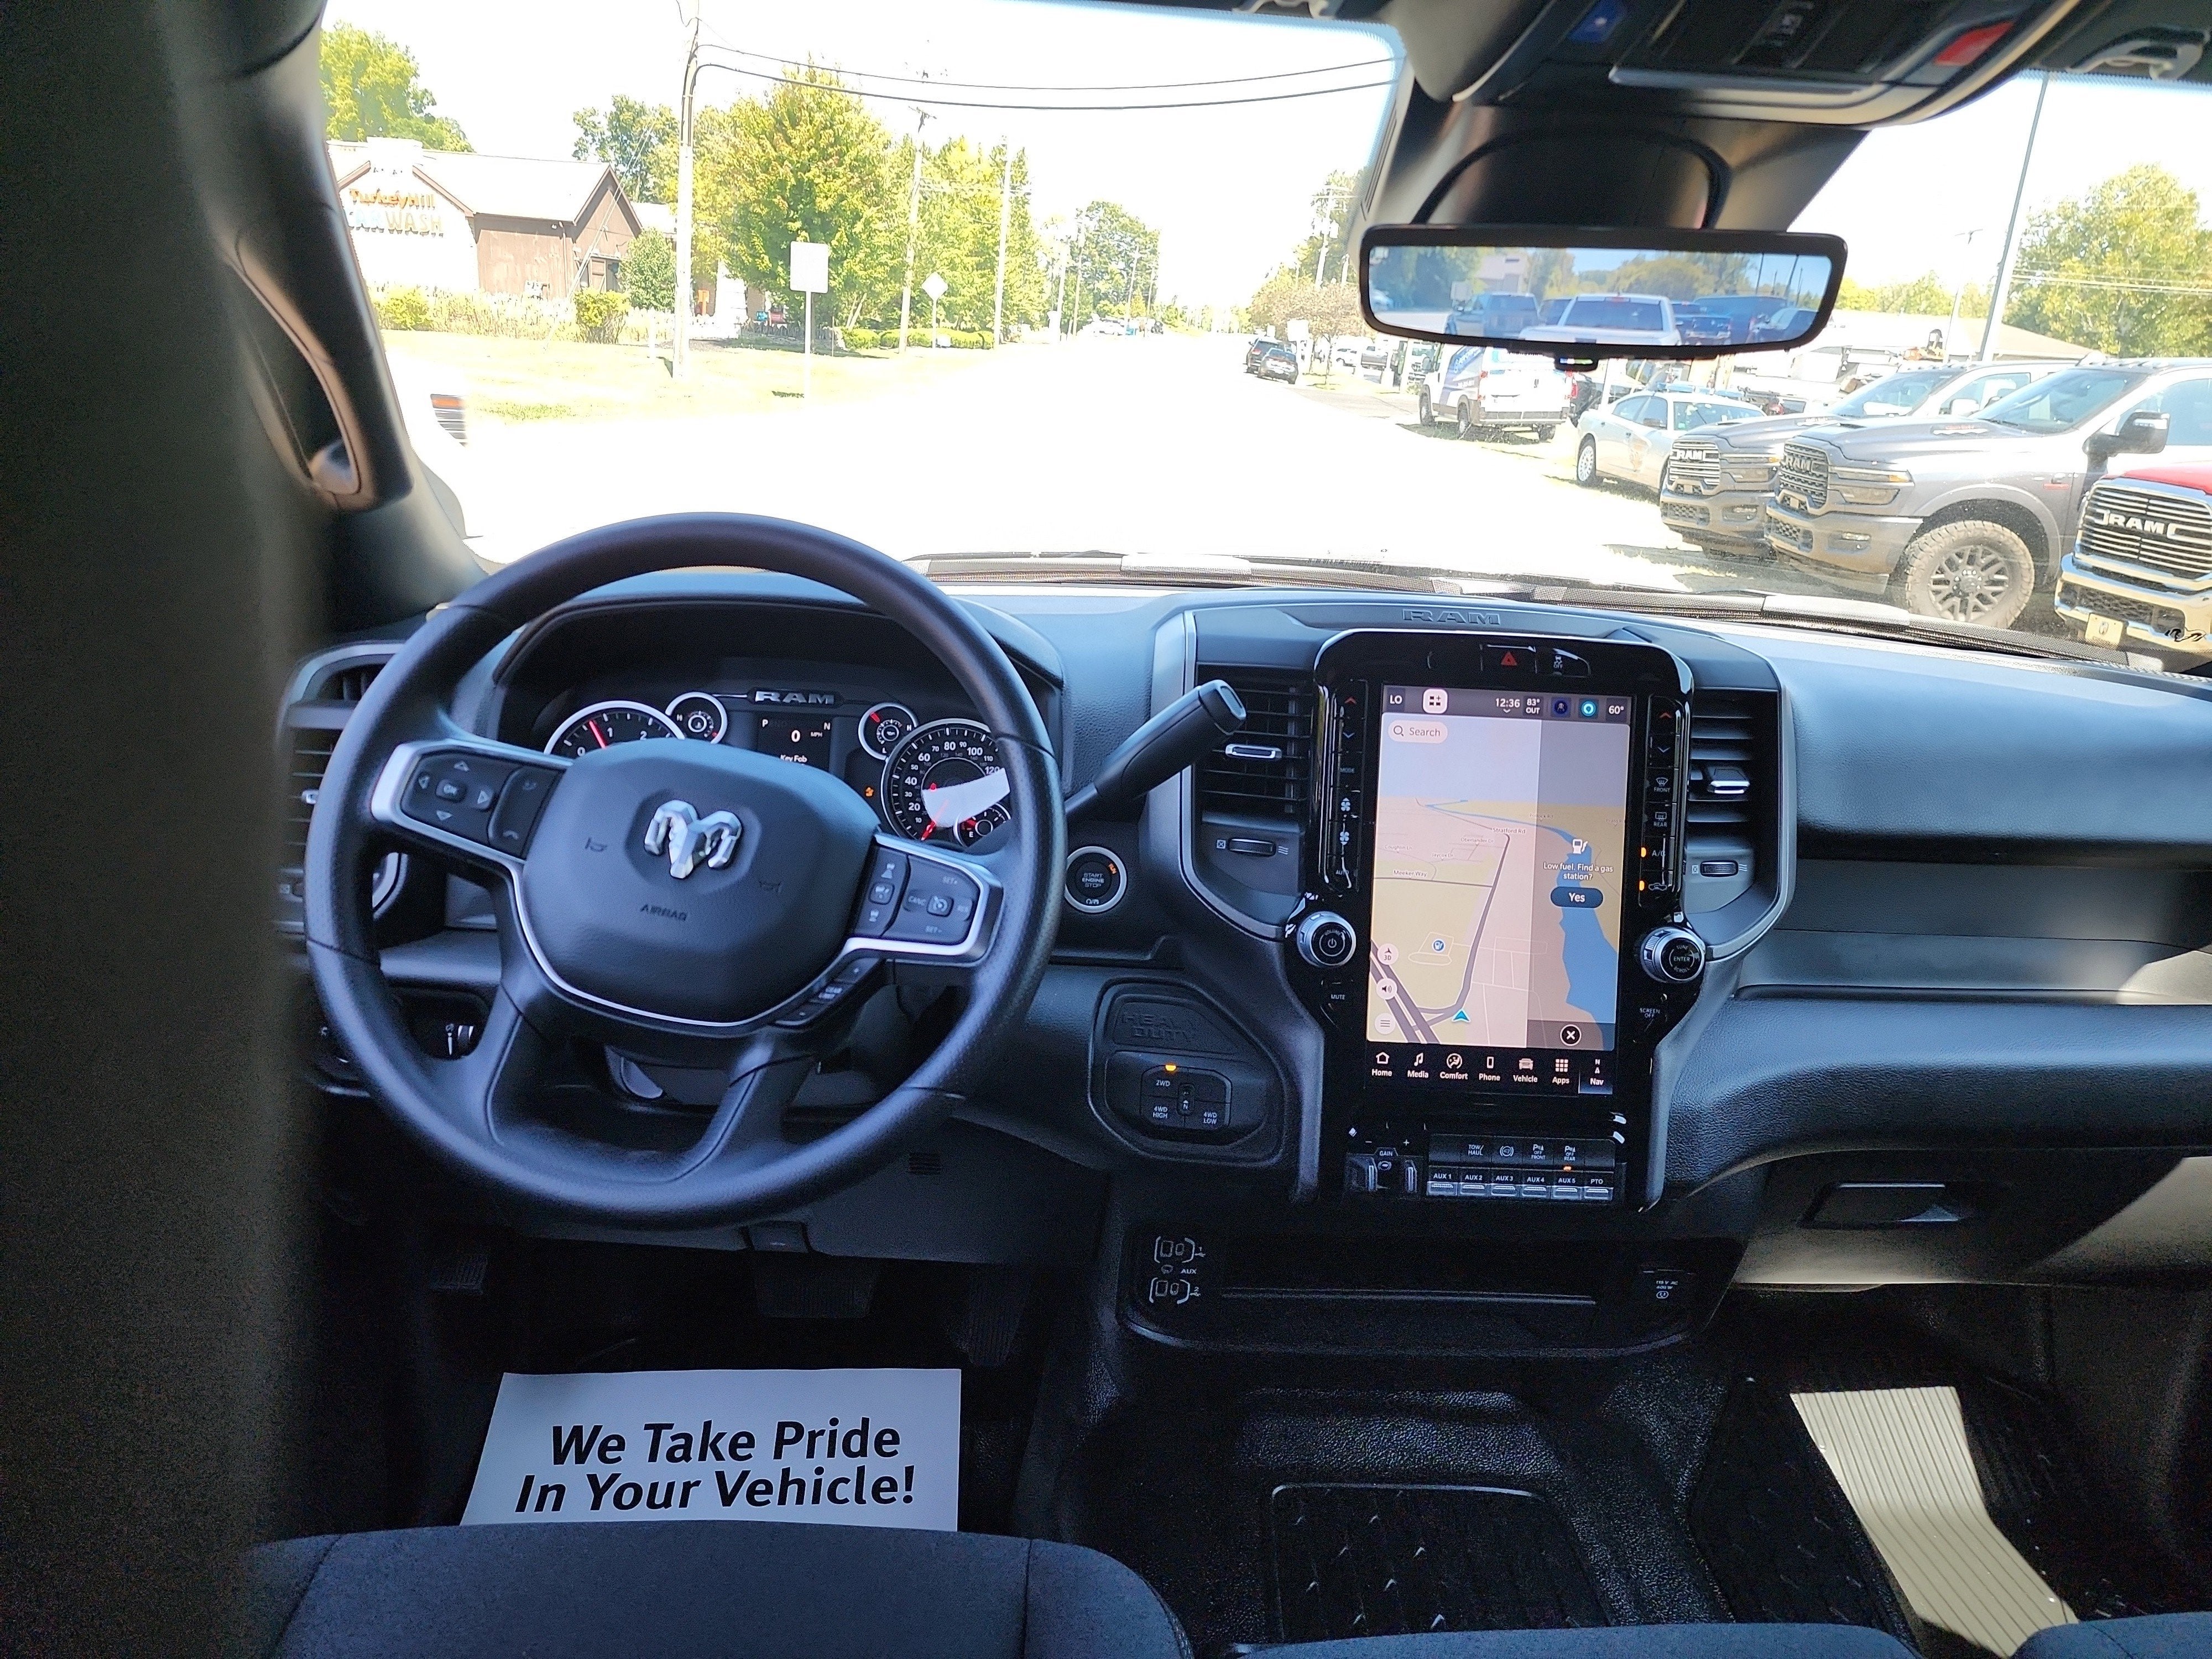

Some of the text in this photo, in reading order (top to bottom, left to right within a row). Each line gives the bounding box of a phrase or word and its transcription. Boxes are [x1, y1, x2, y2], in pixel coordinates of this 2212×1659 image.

[1677, 450, 1703, 460] RAM
[1785, 456, 1812, 471] RAM
[2109, 513, 2164, 535] RAM
[1402, 608, 1500, 625] RAM
[755, 691, 834, 705] RAM
[1390, 695, 1402, 705] LO
[1495, 697, 1520, 708] 12:36
[1527, 698, 1540, 706] 83°
[1608, 705, 1624, 715] 60°
[762, 719, 769, 728] P
[823, 722, 831, 731] N
[608, 727, 613, 738] 1
[640, 730, 648, 741] 2
[791, 729, 801, 743] 0
[1410, 727, 1441, 737] Search
[943, 741, 956, 751] 80
[577, 747, 586, 757] 0
[967, 747, 983, 757] 100
[918, 753, 931, 762] 60
[905, 776, 917, 786] 40
[908, 802, 921, 811] 20
[1577, 863, 1593, 872] Find
[1569, 892, 1585, 902] Yes
[1371, 1068, 1392, 1077] Home
[1439, 1071, 1468, 1080] Comfort
[1479, 1073, 1500, 1081] Phone
[1513, 1074, 1538, 1083] Vehicle
[1552, 1077, 1569, 1085] Apps
[553, 1417, 900, 1465] We Take Pride
[514, 1464, 915, 1512] In Your Vehicle!
